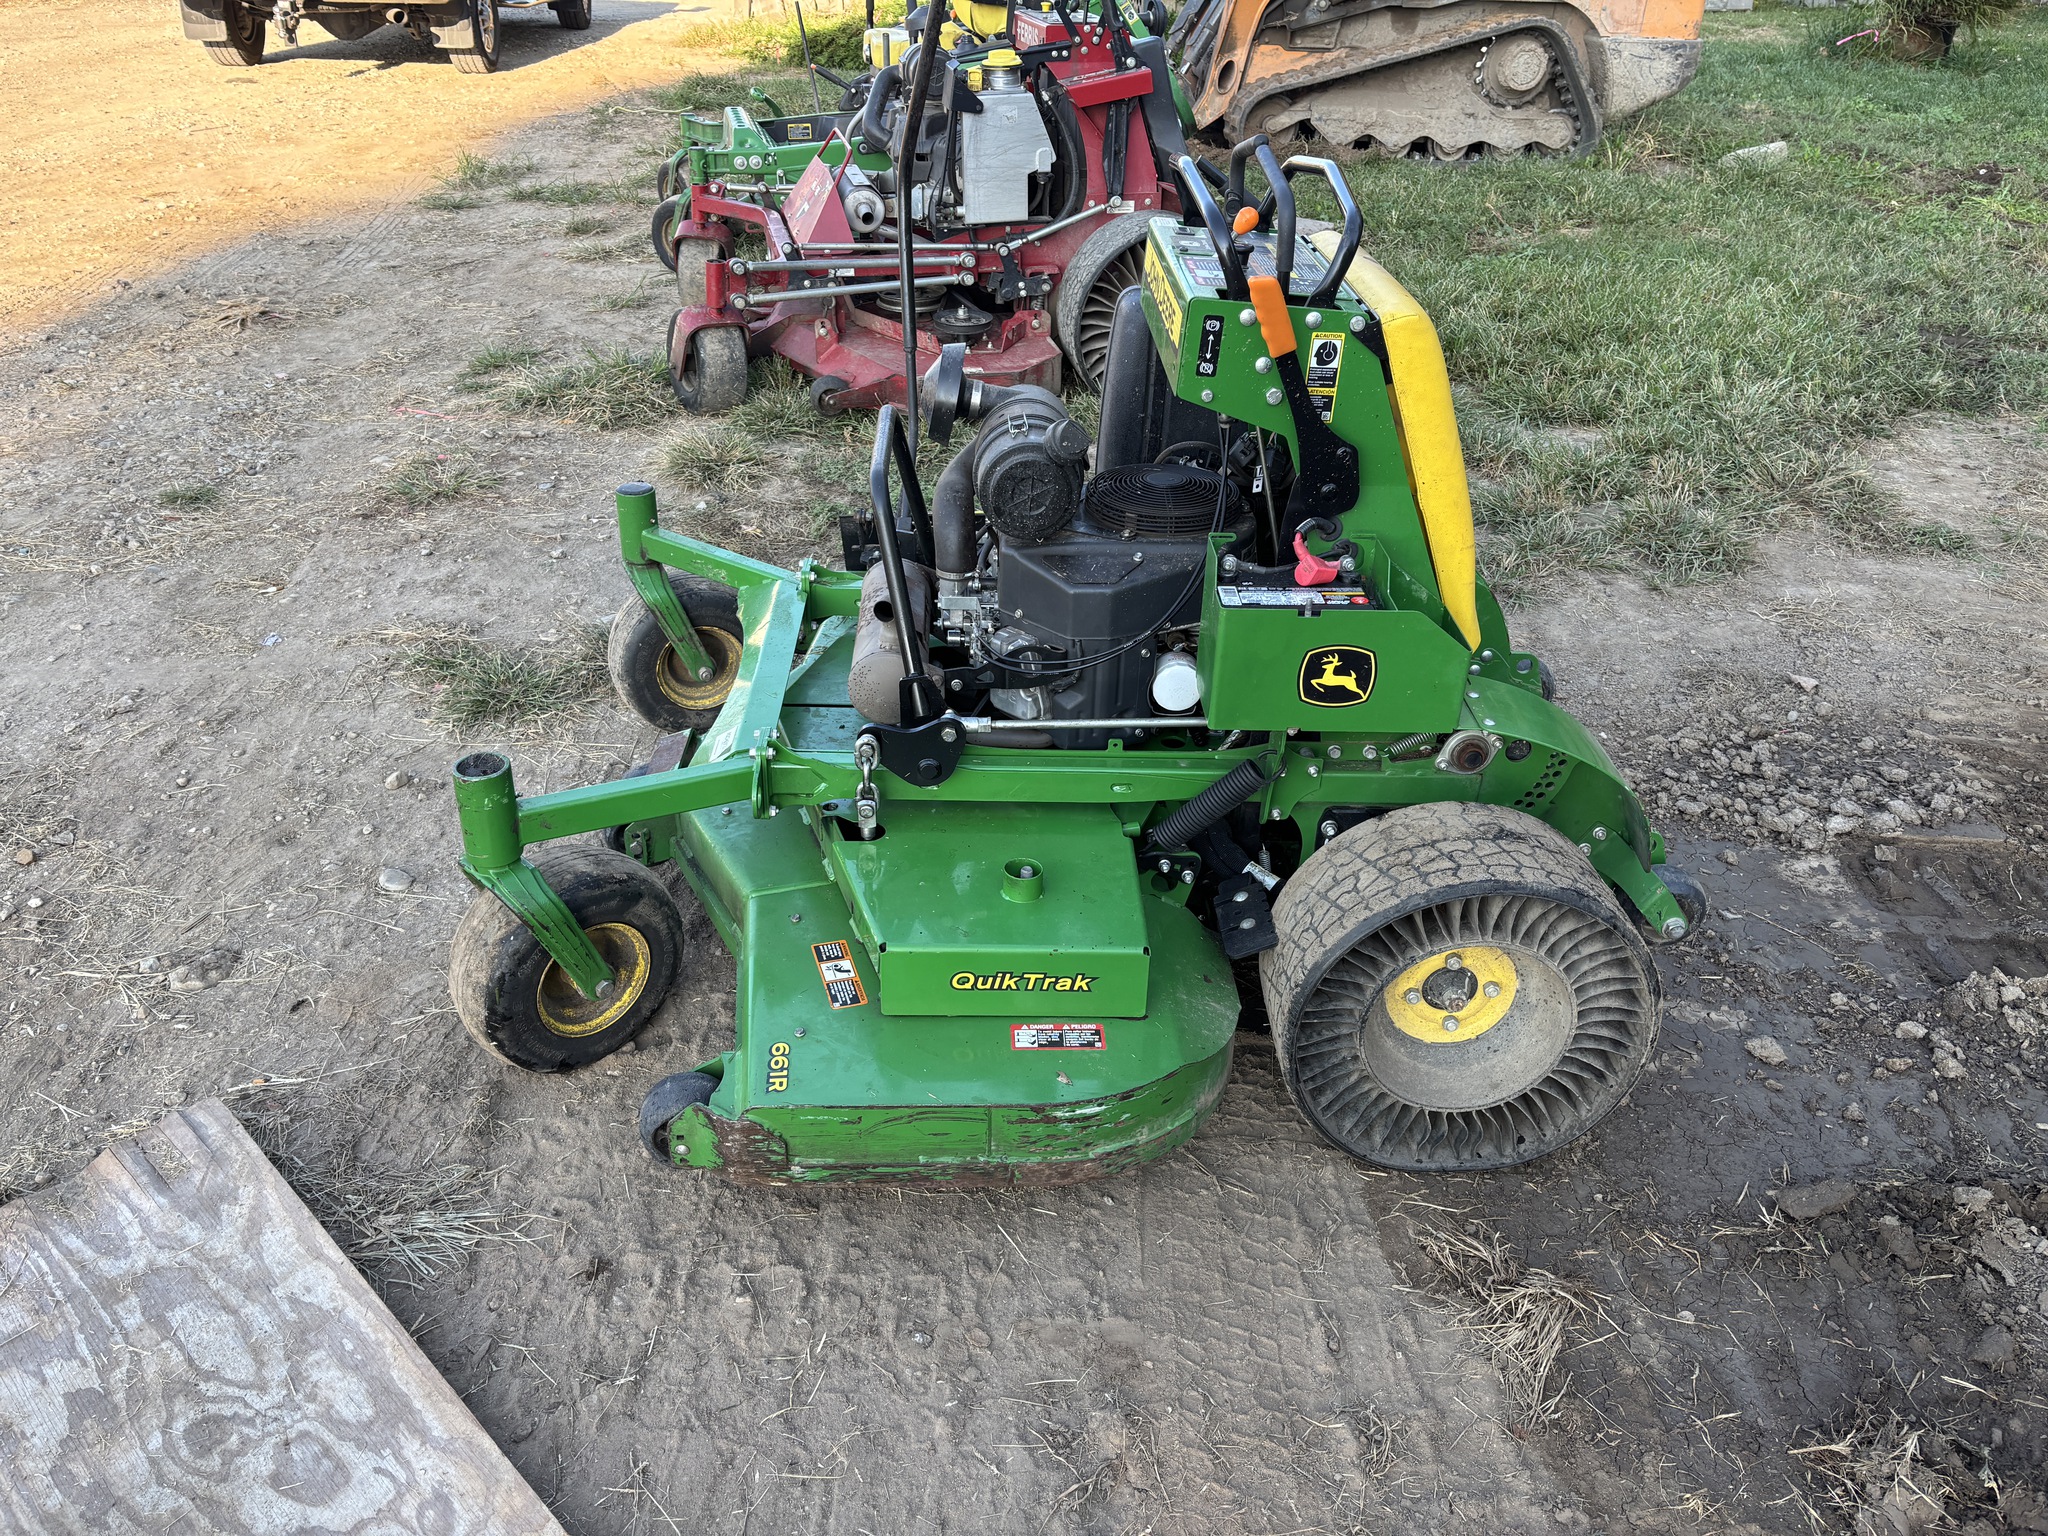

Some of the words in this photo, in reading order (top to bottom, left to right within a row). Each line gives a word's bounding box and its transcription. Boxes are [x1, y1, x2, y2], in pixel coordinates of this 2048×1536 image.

[1017, 20, 1039, 46] FERRIS
[1310, 387, 1335, 395] ATENCIÓN
[951, 971, 1098, 992] QuikTrak
[766, 1042, 791, 1094] 661R
